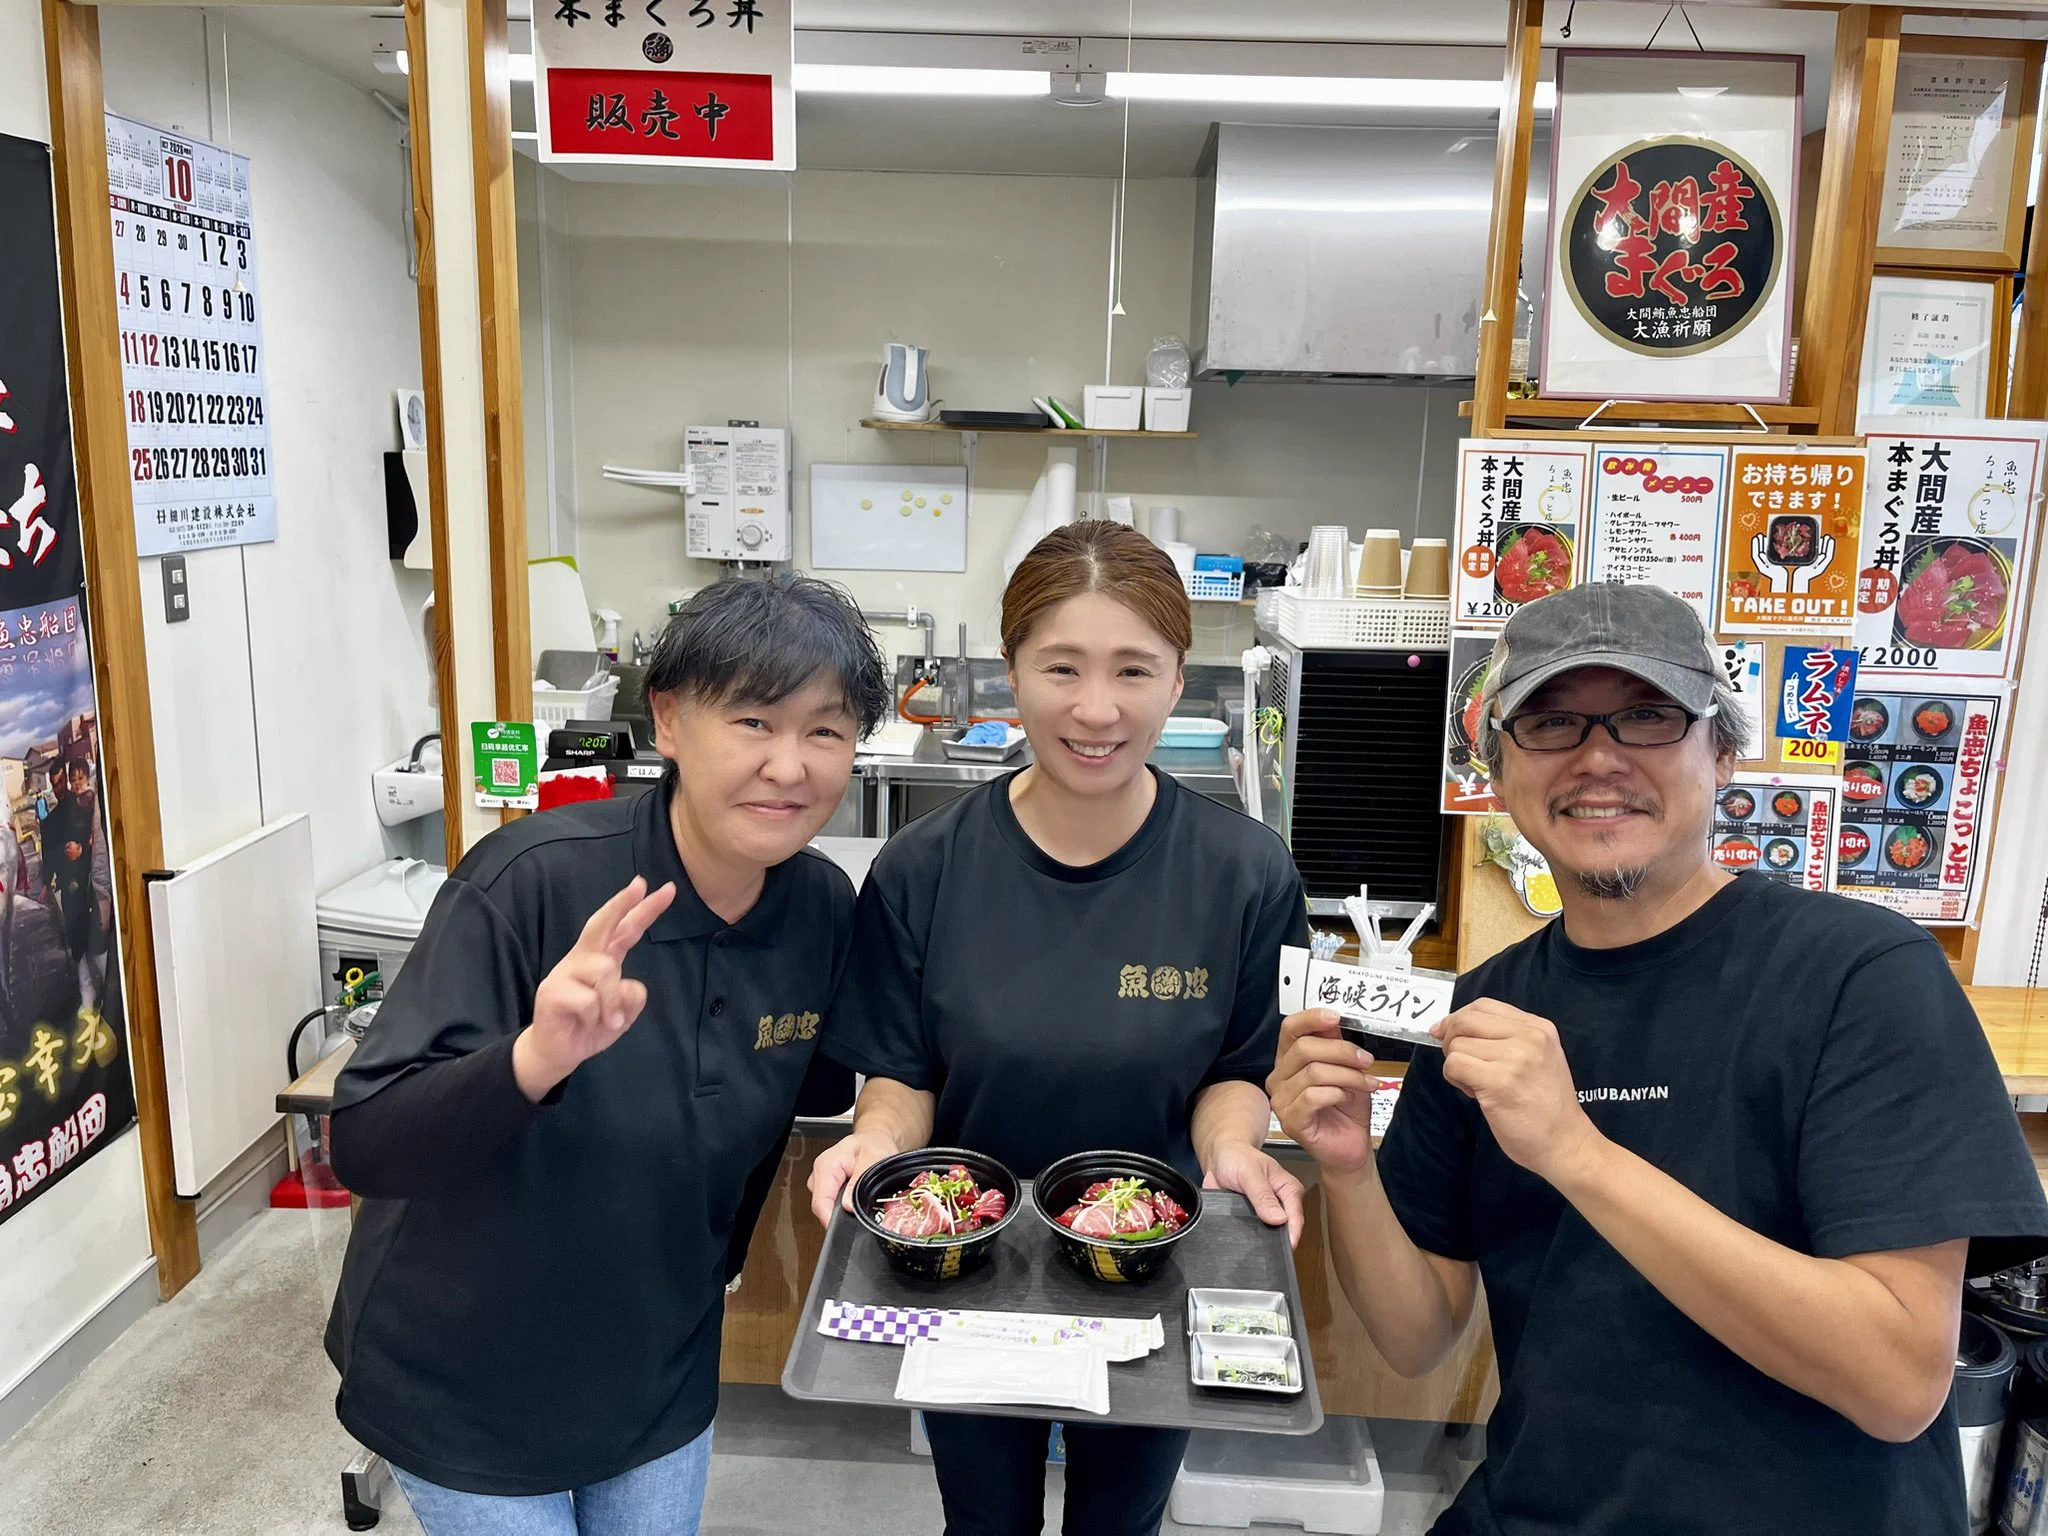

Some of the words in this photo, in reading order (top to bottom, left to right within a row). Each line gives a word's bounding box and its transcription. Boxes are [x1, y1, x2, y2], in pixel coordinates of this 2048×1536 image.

[585, 89, 730, 141] 販売中
[165, 156, 193, 203] 10
[1591, 159, 1755, 244] 大間産
[115, 220, 124, 237] 27
[136, 224, 146, 242] 28
[157, 229, 167, 246] 29
[178, 234, 188, 251] 30
[199, 232, 207, 262] 1
[218, 236, 228, 266] 2
[237, 240, 247, 270] 3
[1604, 217, 1745, 306] まぐろ
[120, 272, 129, 305] 4
[139, 275, 150, 308] 5
[160, 279, 171, 312] 6
[181, 283, 191, 313] 7
[202, 286, 212, 317] 8
[222, 289, 232, 319] 9
[238, 292, 255, 323] 10
[1632, 319, 1712, 339] 大漁祈願
[122, 331, 139, 365] 11
[140, 334, 160, 366] 12
[162, 336, 180, 368] 13
[182, 338, 200, 369] 14
[202, 340, 220, 371] 15
[223, 342, 240, 373] 16
[242, 344, 257, 374] 17
[128, 390, 146, 423] 18
[147, 391, 164, 423] 19
[166, 392, 185, 424] 20
[187, 393, 204, 424] 21
[207, 394, 226, 424] 22
[227, 395, 245, 425] 23
[246, 396, 263, 425] 24
[132, 448, 153, 481] 25
[153, 448, 169, 480] 26
[171, 448, 188, 479] 27
[191, 448, 210, 478] 28
[211, 448, 230, 477] 29
[231, 447, 249, 476] 30
[250, 448, 266, 476] 31
[1741, 463, 1854, 486] お持ち帰り
[2002, 461, 2018, 495] 魚忠
[1477, 455, 1499, 547] 本まぐろ丼
[1500, 456, 1524, 521] 大間産
[1647, 479, 1708, 489] メニュー
[1681, 495, 1703, 504] 500円
[1910, 441, 1951, 534] 大間産
[1873, 441, 1915, 571] 本まぐろ丼
[1679, 533, 1701, 541] 400円
[1681, 554, 1703, 562] 300円
[1730, 596, 1786, 614] TAKE
[1859, 578, 1872, 603] 限定
[1875, 578, 1890, 604] 期間
[1467, 601, 1524, 616] ¥200
[1796, 652, 1836, 736] ラムネ
[1944, 713, 1989, 884] 魚忠ちょこっと店
[1713, 849, 1759, 861] 売り切れ
[1318, 975, 1436, 1019] 海峡ライン
[1575, 1086, 1669, 1103] SUKUBANYAN
